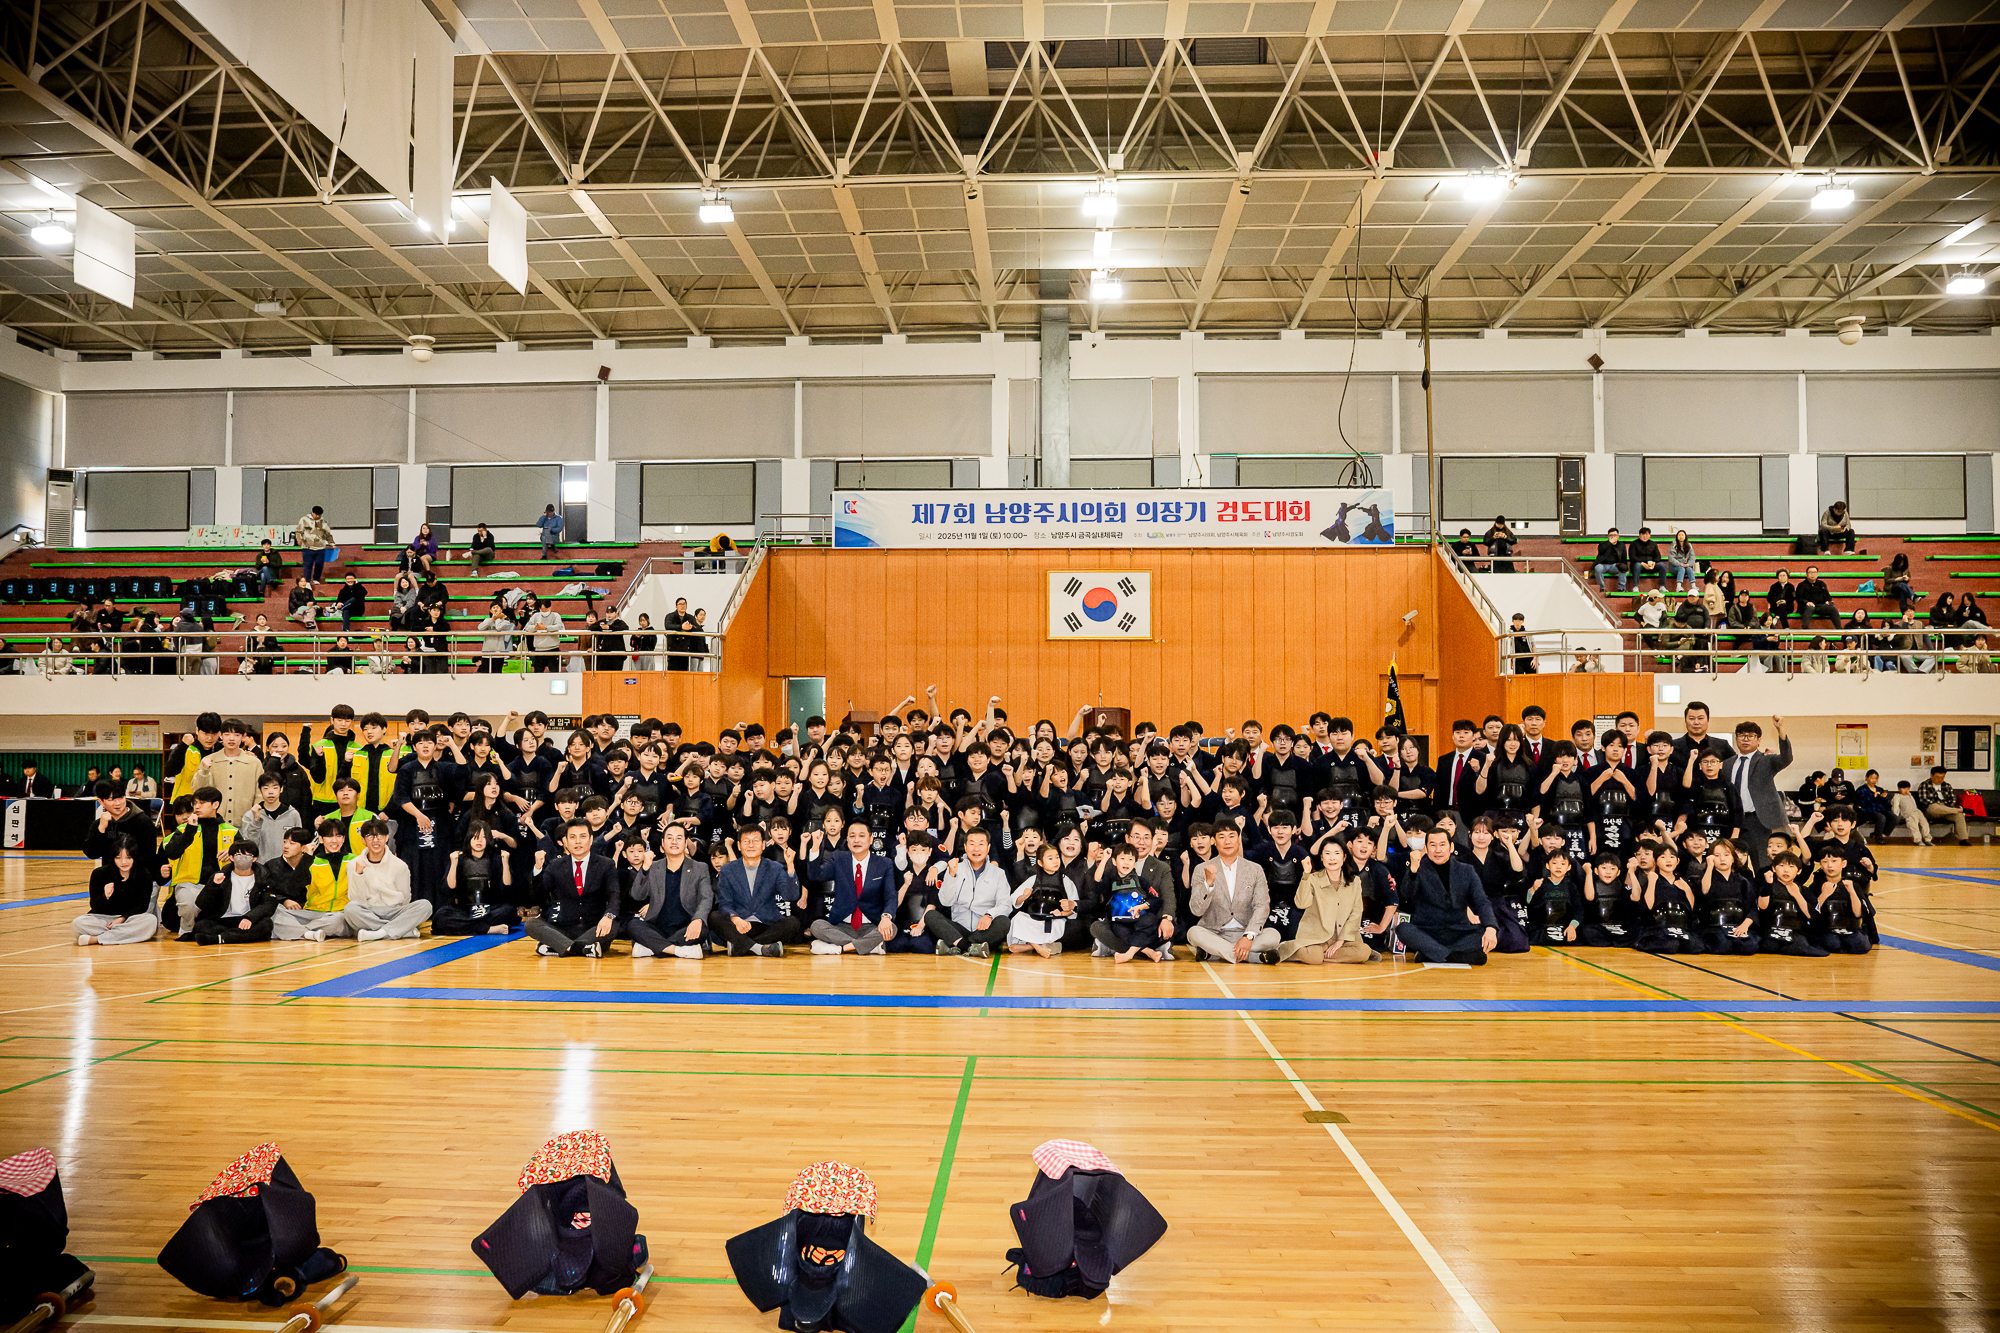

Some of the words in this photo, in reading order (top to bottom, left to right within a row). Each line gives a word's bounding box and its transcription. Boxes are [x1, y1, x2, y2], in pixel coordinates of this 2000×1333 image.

[911, 502, 975, 524] 제7회
[985, 501, 1126, 524] 남양주시의회
[1136, 501, 1206, 523] 의장기
[1216, 500, 1311, 522] 검도대회
[937, 532, 963, 540] 2025년
[1050, 531, 1077, 539] 남양주시
[557, 718, 571, 727] 입구
